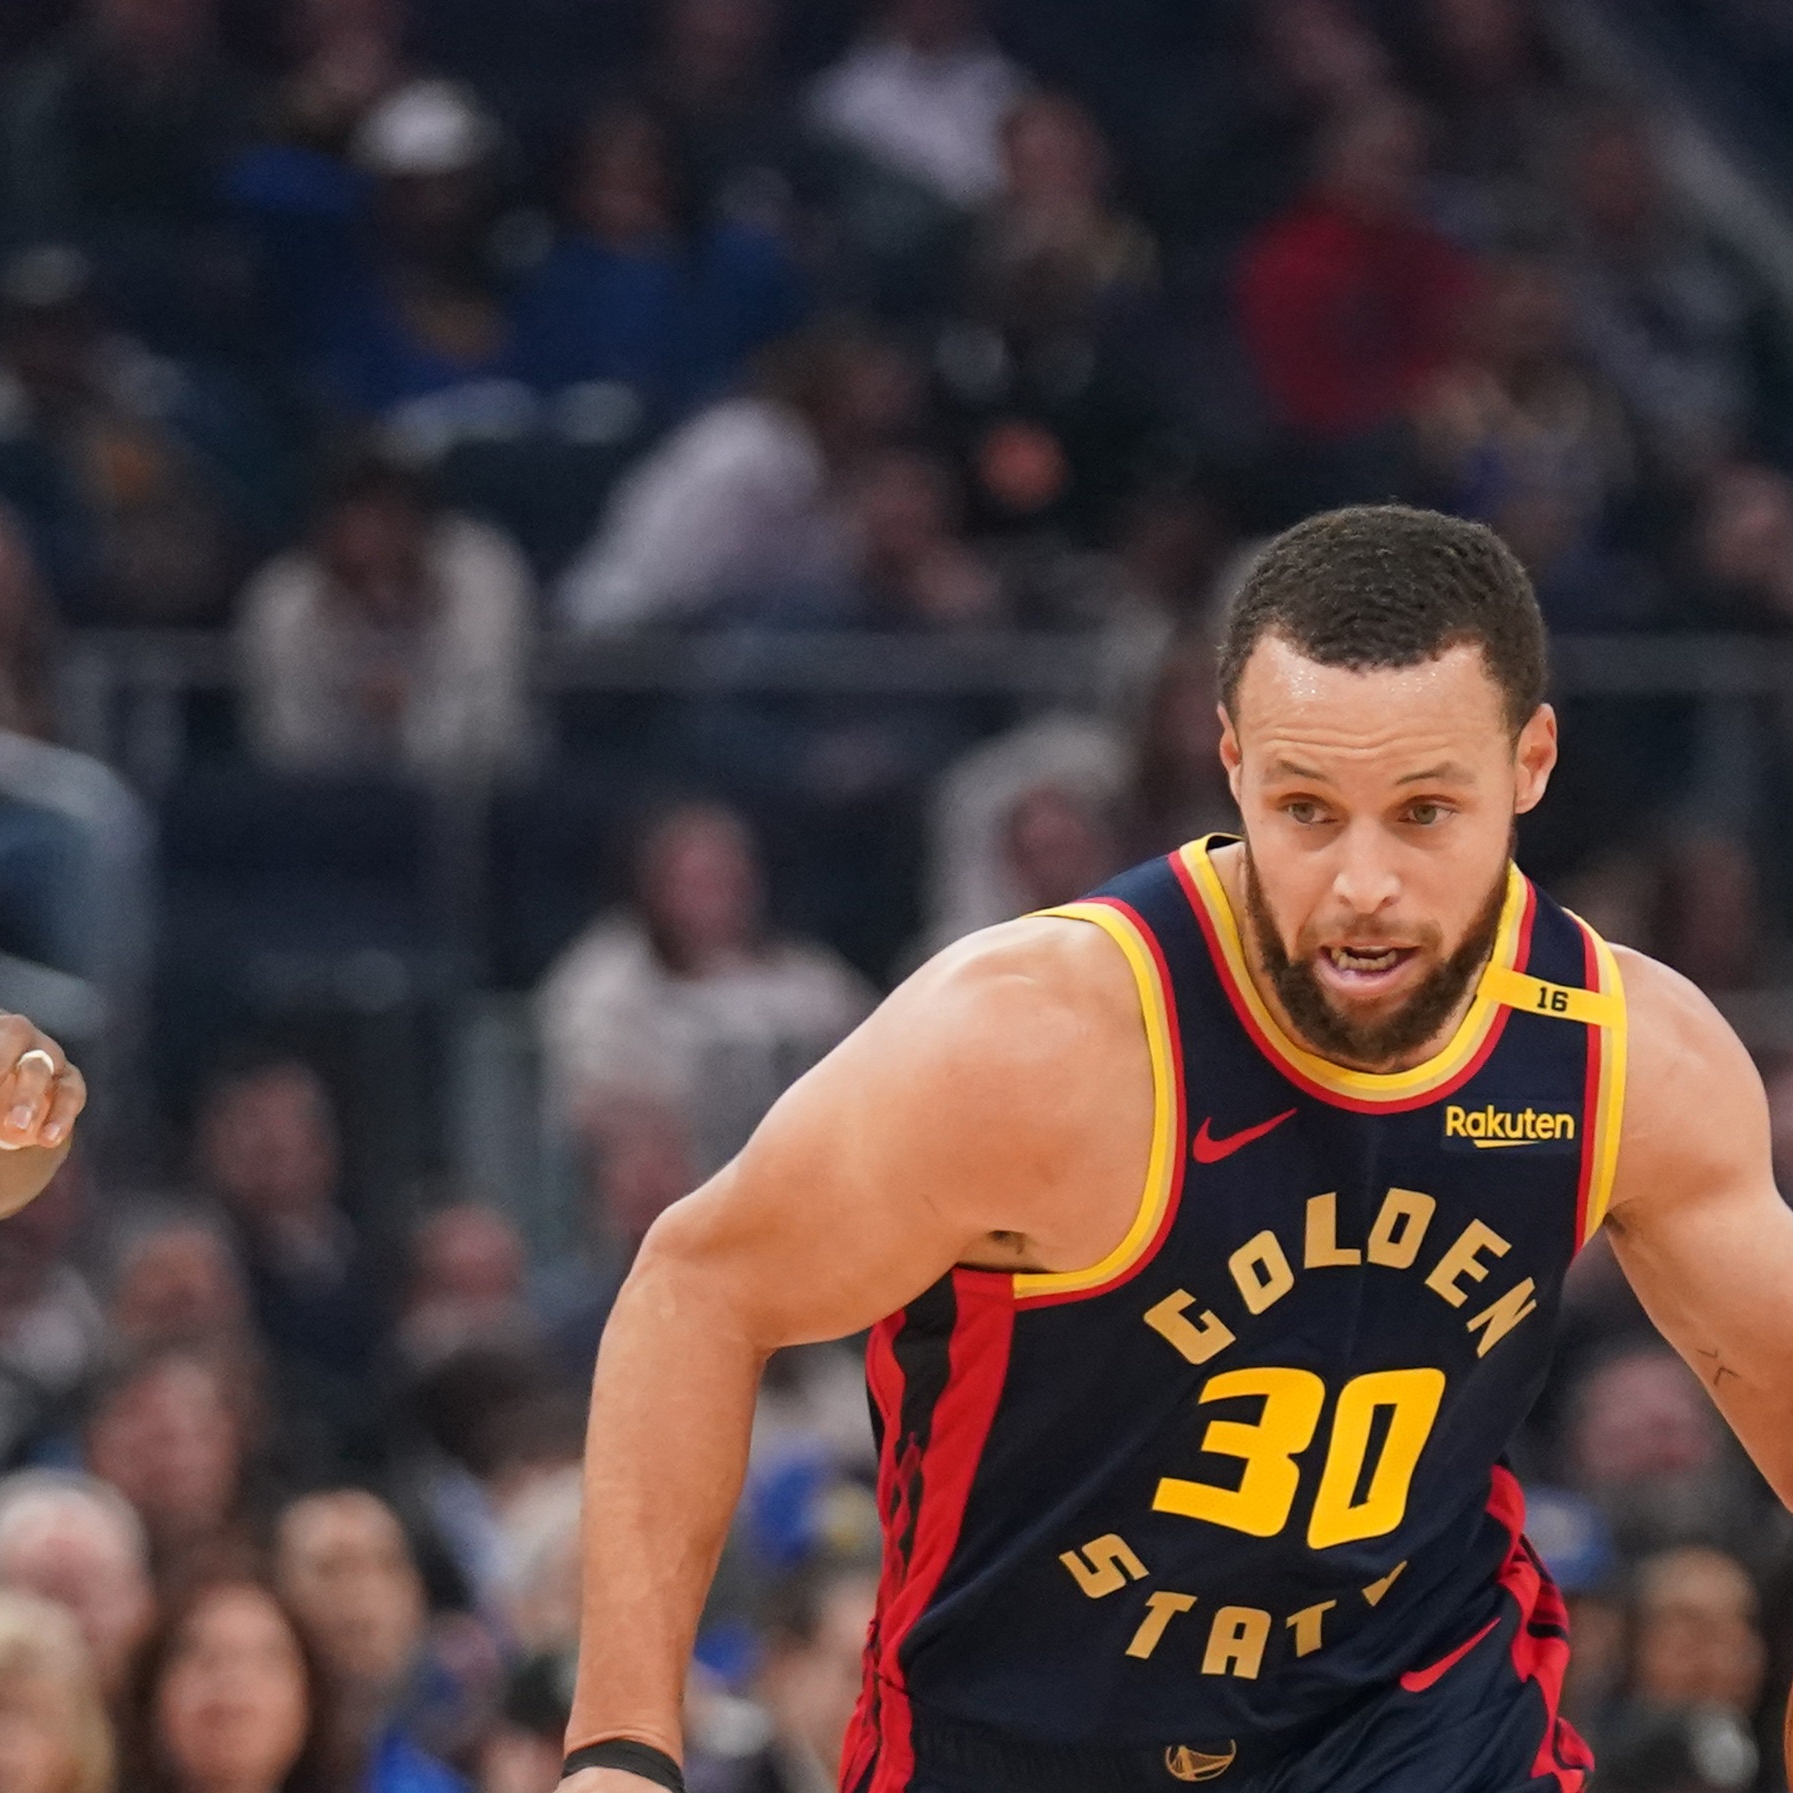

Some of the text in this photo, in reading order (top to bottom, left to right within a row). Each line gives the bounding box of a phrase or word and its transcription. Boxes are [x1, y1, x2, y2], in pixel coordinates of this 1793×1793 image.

[1537, 986, 1569, 1012] 16
[1445, 1104, 1576, 1140] Rakuten
[1143, 1187, 1538, 1366] GOLDEN
[1152, 1367, 1446, 1550] 30
